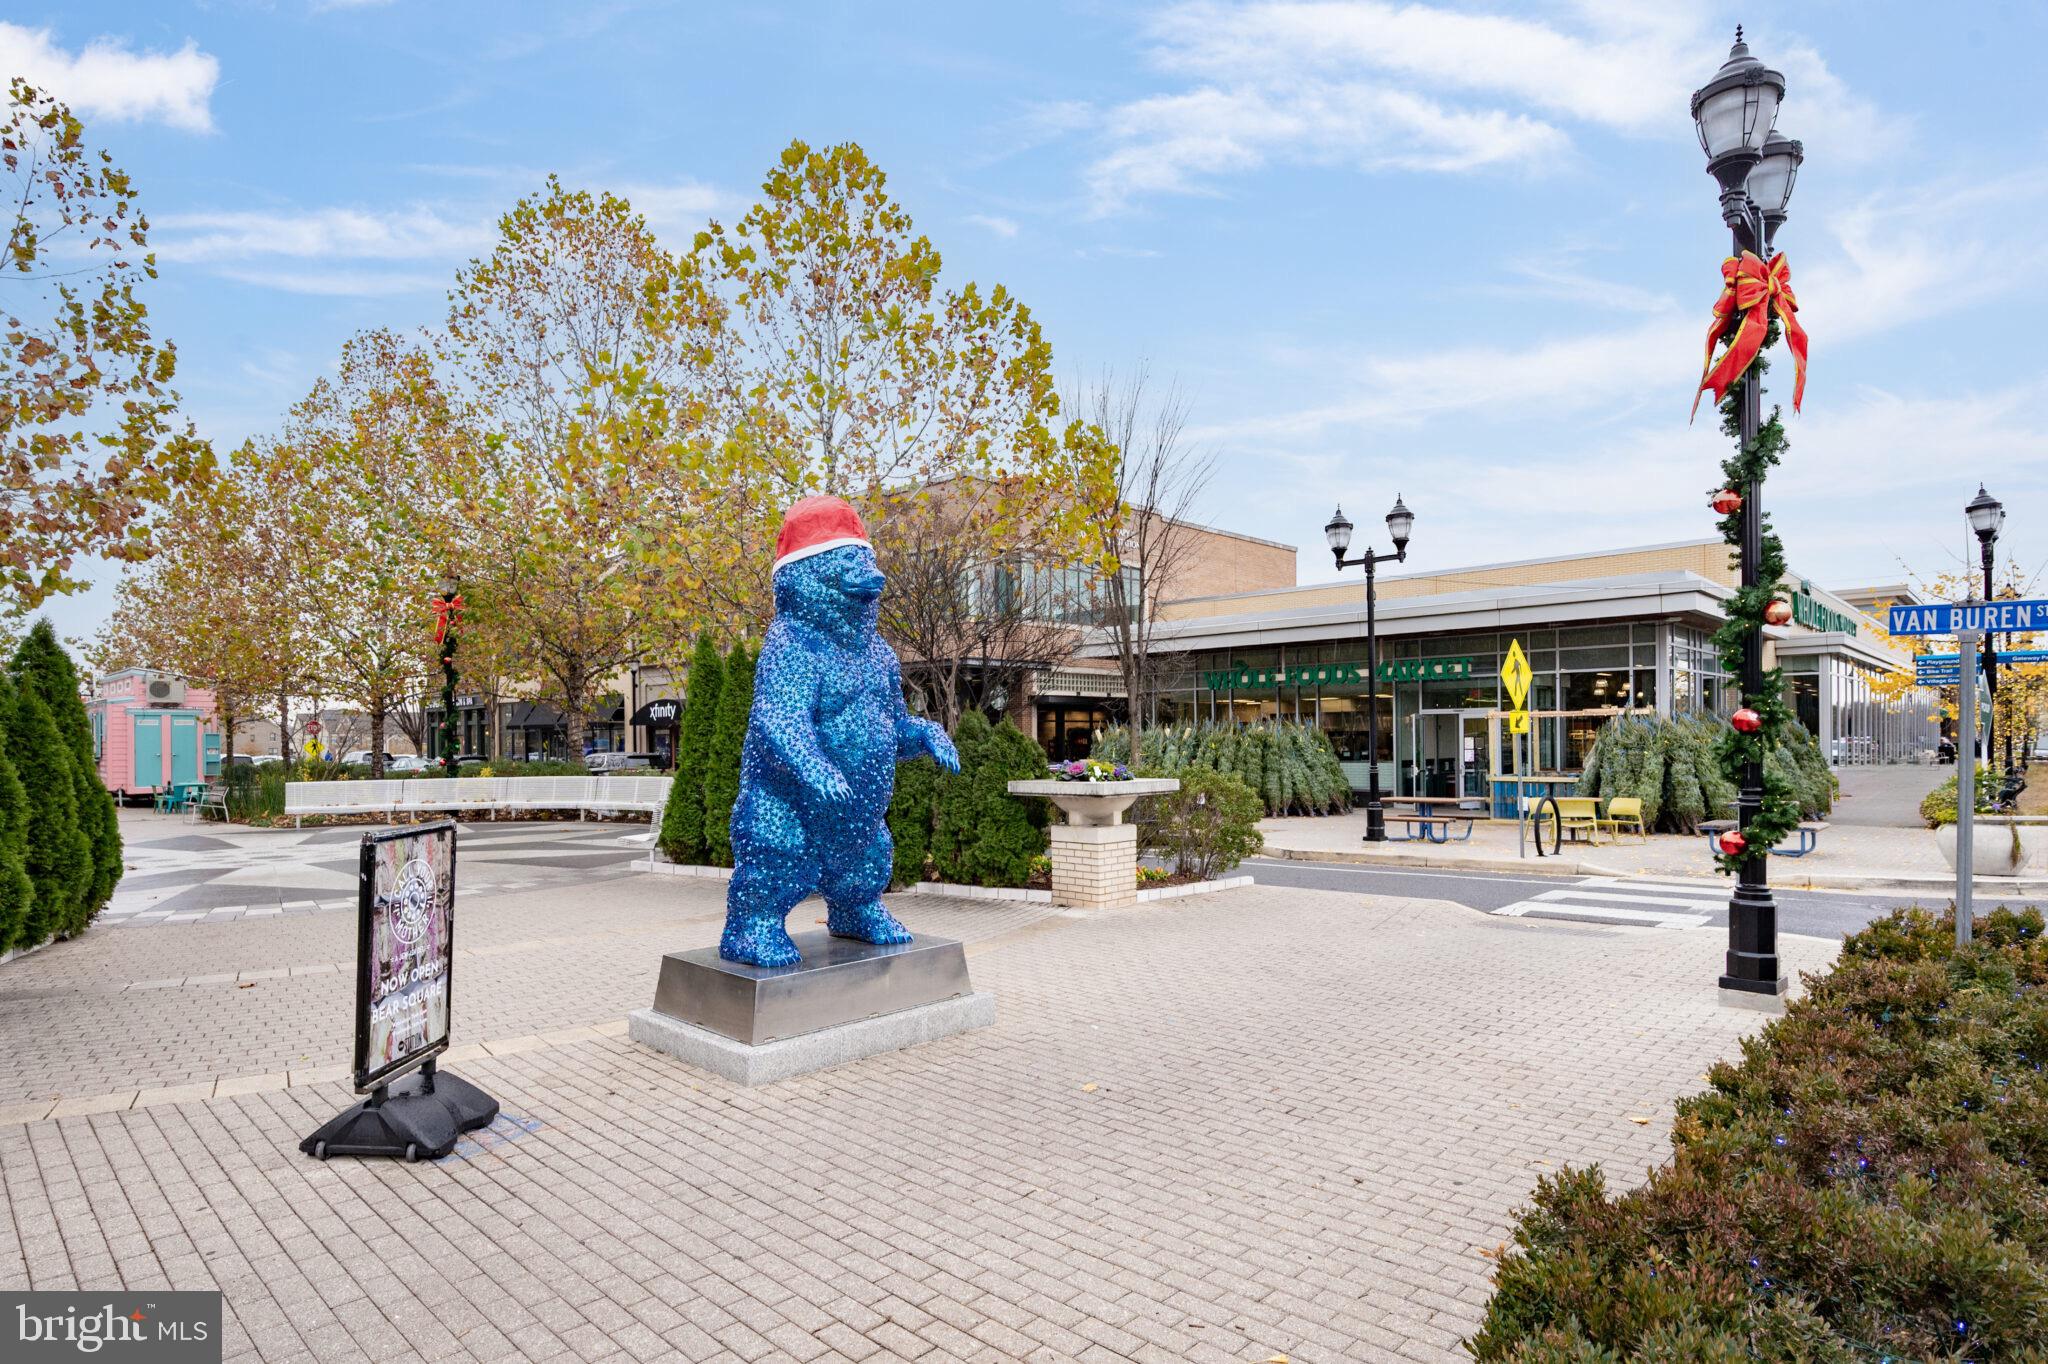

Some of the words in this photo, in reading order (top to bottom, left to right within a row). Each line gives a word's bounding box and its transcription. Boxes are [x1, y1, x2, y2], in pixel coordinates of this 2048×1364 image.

[1893, 609, 1938, 632] VAN
[1951, 605, 2032, 630] BUREN
[1204, 661, 1280, 690] WHOLE
[1285, 661, 1361, 687] FOODS
[650, 702, 676, 721] xfinity
[394, 866, 414, 898] CALL
[416, 864, 434, 892] YOUR
[394, 913, 430, 939] MOTHER
[381, 972, 408, 995] NOW
[410, 960, 439, 982] OPEN
[371, 1001, 400, 1024] BEAR
[401, 981, 442, 1010] SQUARE
